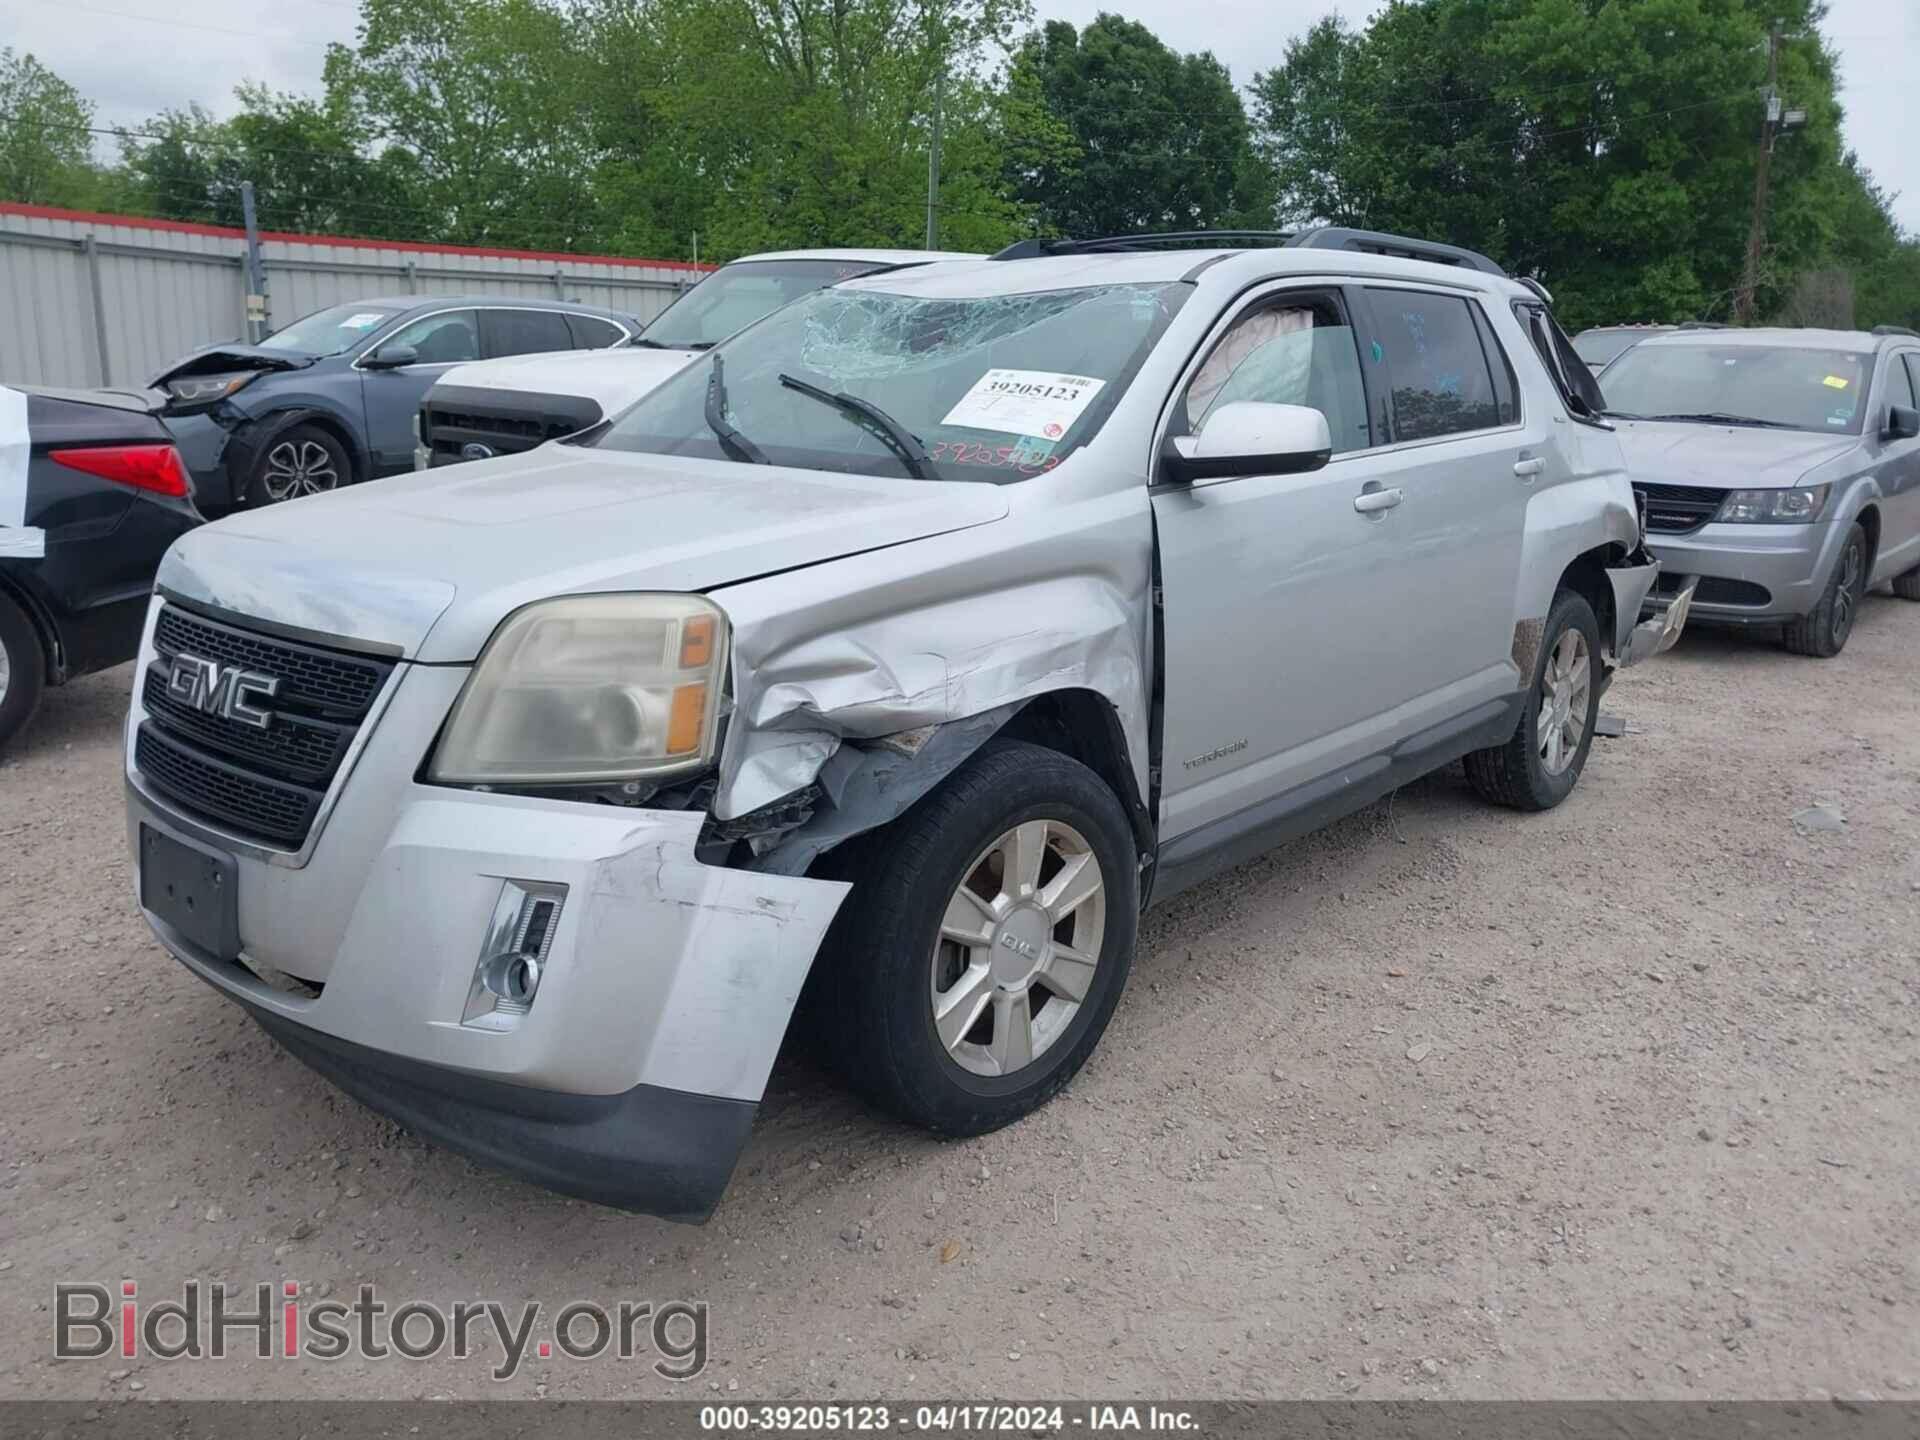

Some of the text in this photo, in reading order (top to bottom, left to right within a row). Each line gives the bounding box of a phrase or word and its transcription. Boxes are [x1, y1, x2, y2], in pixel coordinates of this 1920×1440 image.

[985, 381, 1079, 400] 39205123
[168, 652, 281, 729] GMC
[1183, 737, 1249, 770] TERRAIN
[1000, 932, 1037, 960] GMC
